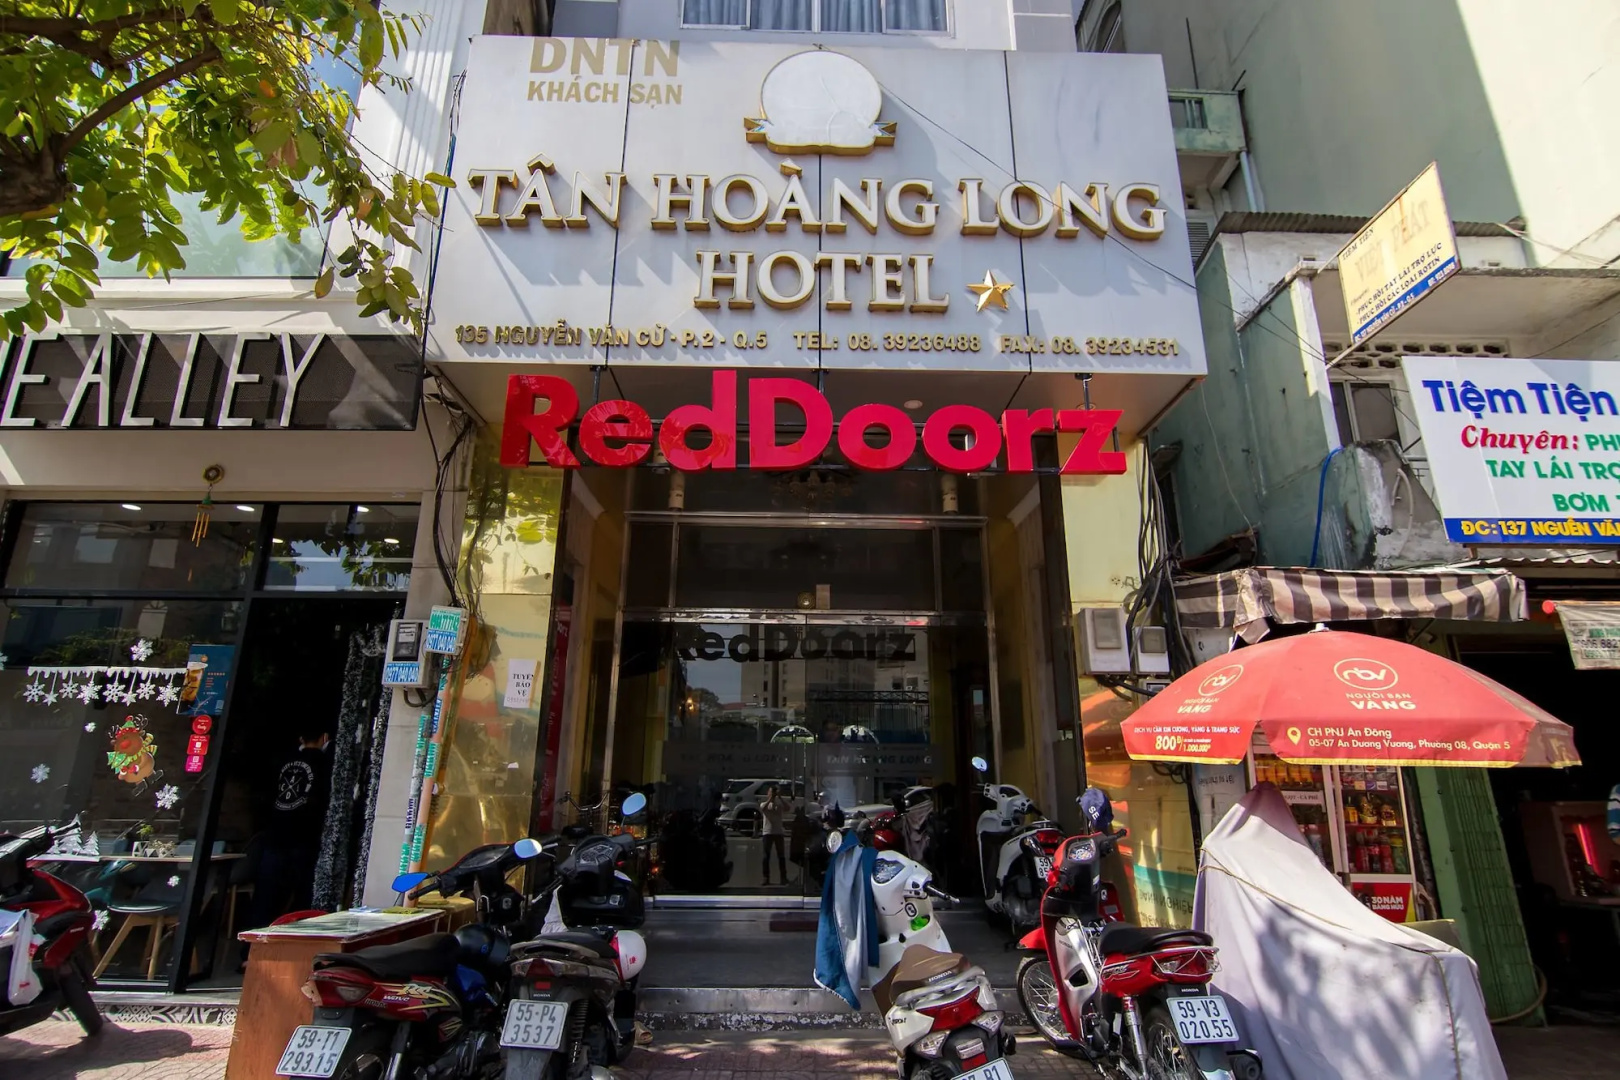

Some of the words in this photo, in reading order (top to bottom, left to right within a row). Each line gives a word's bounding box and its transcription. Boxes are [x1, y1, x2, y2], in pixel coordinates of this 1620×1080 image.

[529, 37, 681, 77] DNTN
[527, 76, 619, 104] KHÁCH
[629, 83, 683, 109] SẠN
[467, 153, 628, 229] TÂN
[650, 158, 940, 235] HOÀNG
[958, 178, 1167, 241] LONG
[694, 251, 949, 312] HOTEL
[455, 325, 488, 344] 135
[494, 318, 582, 346] NGUYỄN
[588, 324, 630, 346] VĂN
[635, 323, 667, 346] CỪ
[681, 330, 715, 348] P.2
[733, 331, 768, 349] Q.5
[793, 331, 838, 350] TEL:
[848, 333, 878, 351] 08.
[883, 333, 982, 351] 39236488
[1000, 335, 1045, 354] FAX:
[1051, 336, 1080, 354] 08.
[1085, 337, 1179, 356] 39234531
[0, 332, 326, 428] EALLEY
[1422, 380, 1527, 420] Tiệm
[1527, 382, 1620, 422] Tiện
[500, 370, 1128, 476] RedDoorz
[1461, 425, 1579, 455] Chuyên:
[1584, 433, 1620, 451] PH
[1485, 459, 1525, 478] TAY
[1534, 455, 1574, 479] LÁI
[1552, 491, 1611, 513] BƠM
[1593, 519, 1620, 537] VĂ
[1601, 639, 1620, 648] 882
[1177, 703, 1212, 714] VÀNG
[1350, 698, 1417, 710] VÀNG
[1307, 728, 1322, 736] CH
[1325, 728, 1344, 736] PNJ
[1347, 728, 1362, 737] An
[1364, 727, 1392, 739] Đông
[1308, 739, 1334, 747] 05-07
[1454, 741, 1471, 750] 08,
[1472, 741, 1501, 750] Quận
[1504, 742, 1511, 750] 5
[928, 970, 952, 982] HONDA
[516, 1003, 557, 1023] 55-P4
[1176, 1000, 1221, 1019] 59-V3
[297, 1029, 341, 1051] 59-T1
[511, 1024, 555, 1045] 3537
[1179, 1019, 1234, 1039] 020.55
[281, 1051, 338, 1074] 293.15
